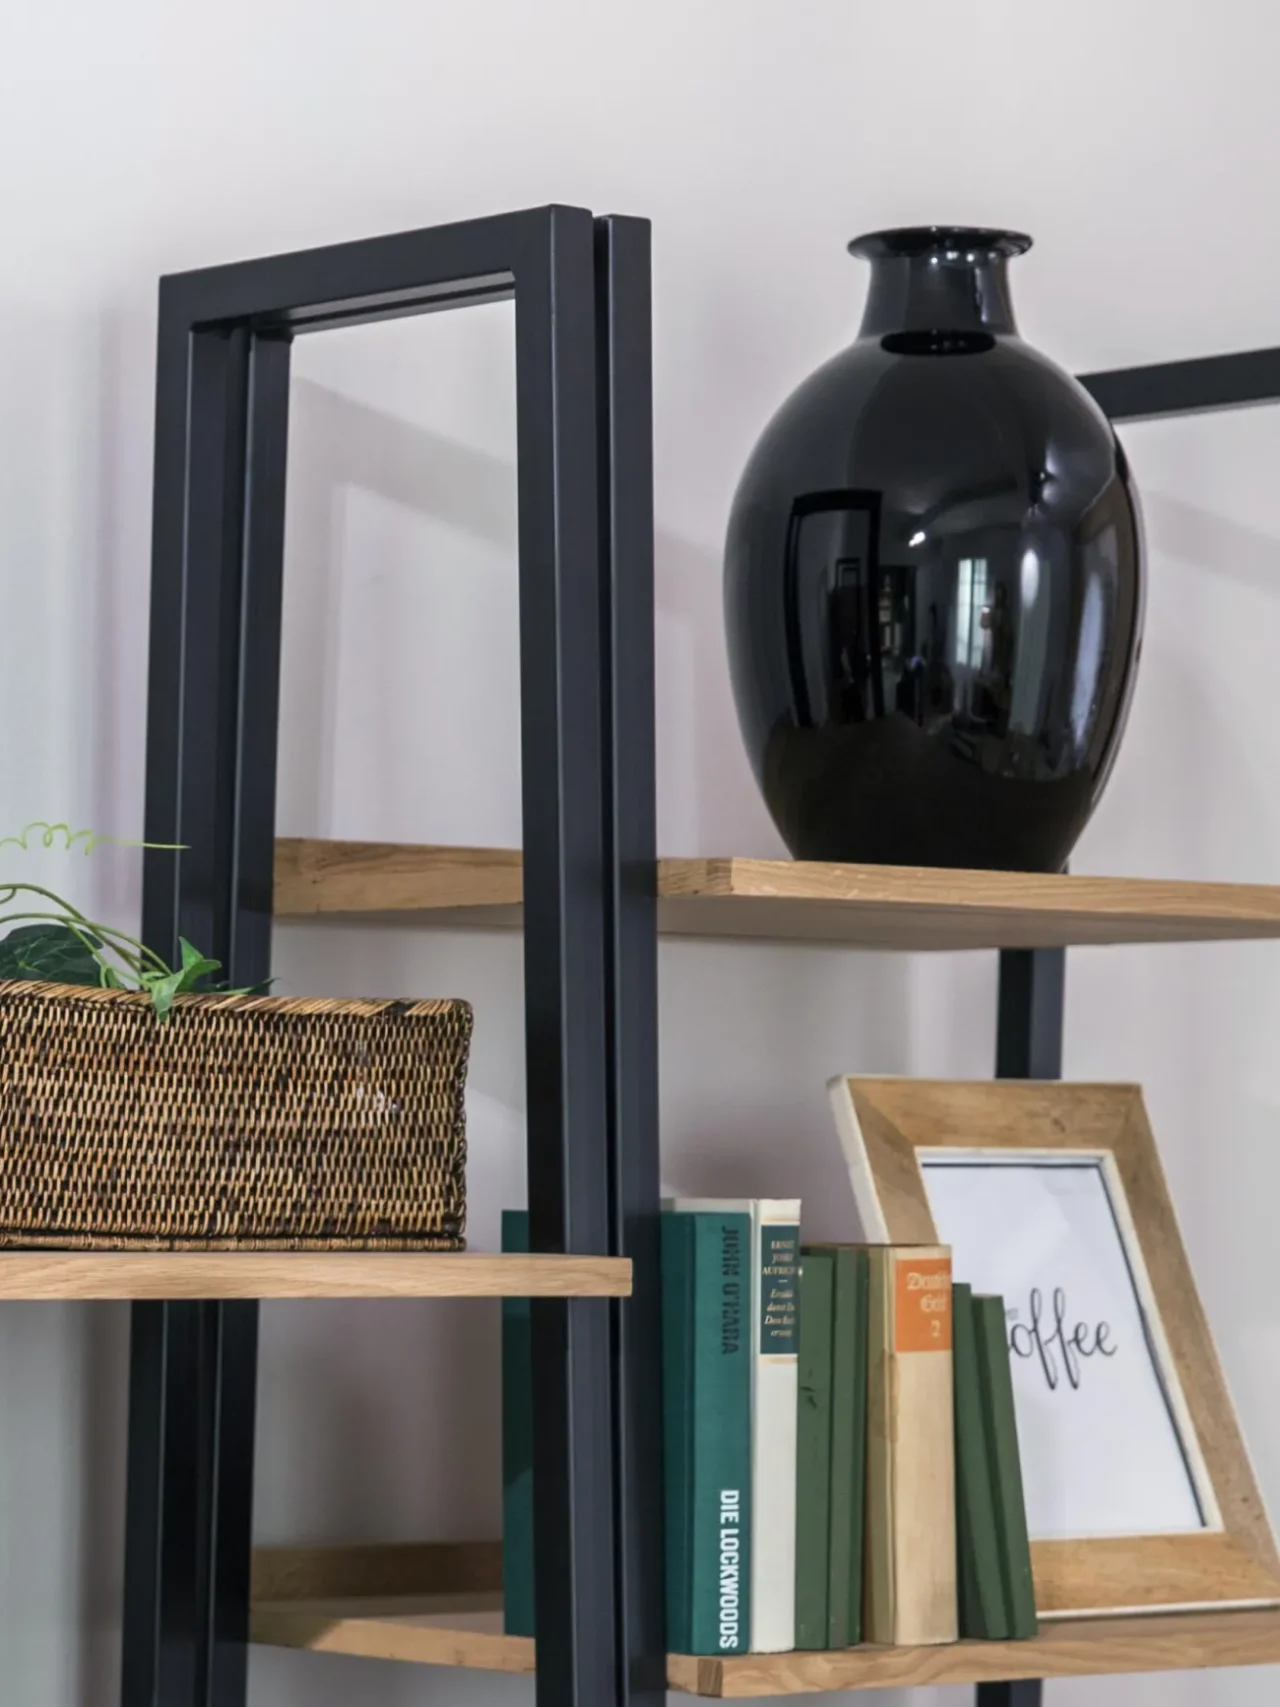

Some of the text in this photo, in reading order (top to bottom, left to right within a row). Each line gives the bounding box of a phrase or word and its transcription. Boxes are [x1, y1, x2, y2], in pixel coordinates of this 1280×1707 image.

[721, 1225, 740, 1276] JOHN
[1008, 1287, 1118, 1391] offee
[719, 1489, 740, 1649] DIE LOCKWOODS
